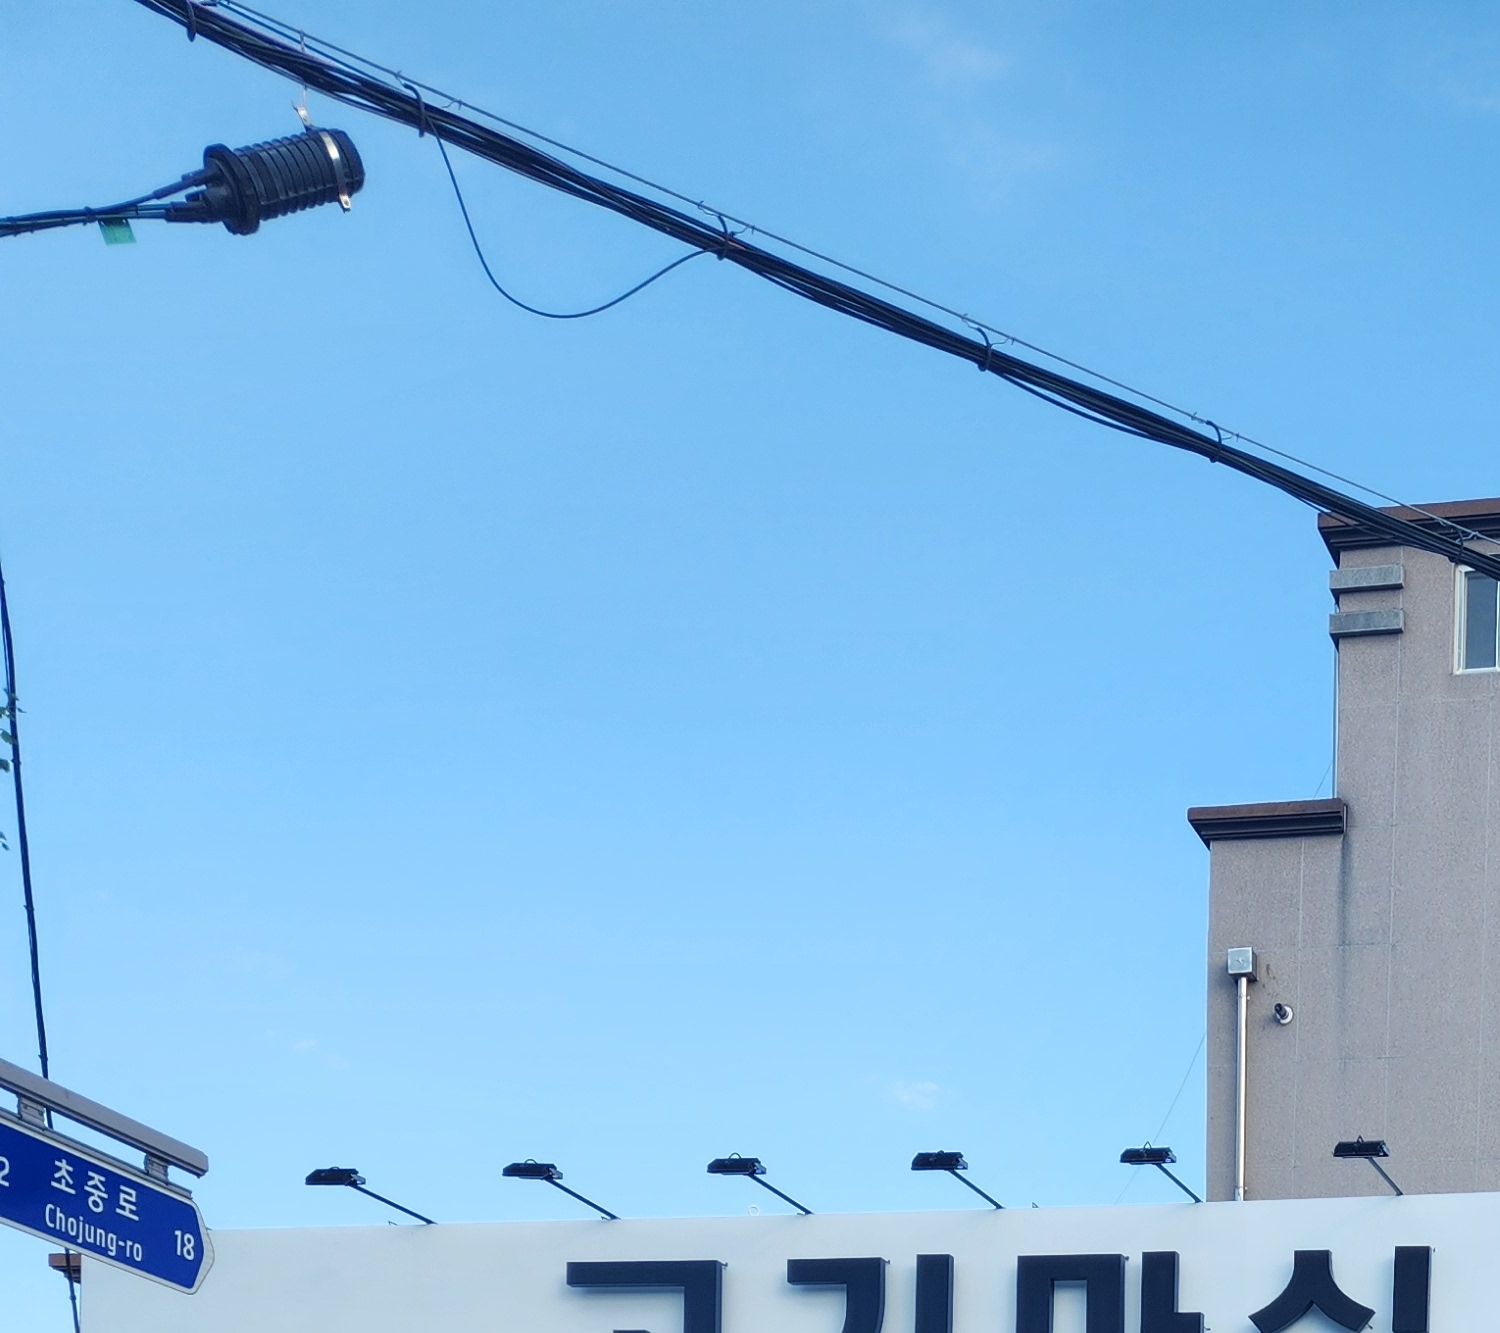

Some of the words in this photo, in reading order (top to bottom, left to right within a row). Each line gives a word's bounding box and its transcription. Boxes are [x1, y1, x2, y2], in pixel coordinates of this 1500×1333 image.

[44, 1203, 143, 1262] Chojung-ro
[50, 1158, 140, 1221] 초중로
[174, 1229, 195, 1261] 18
